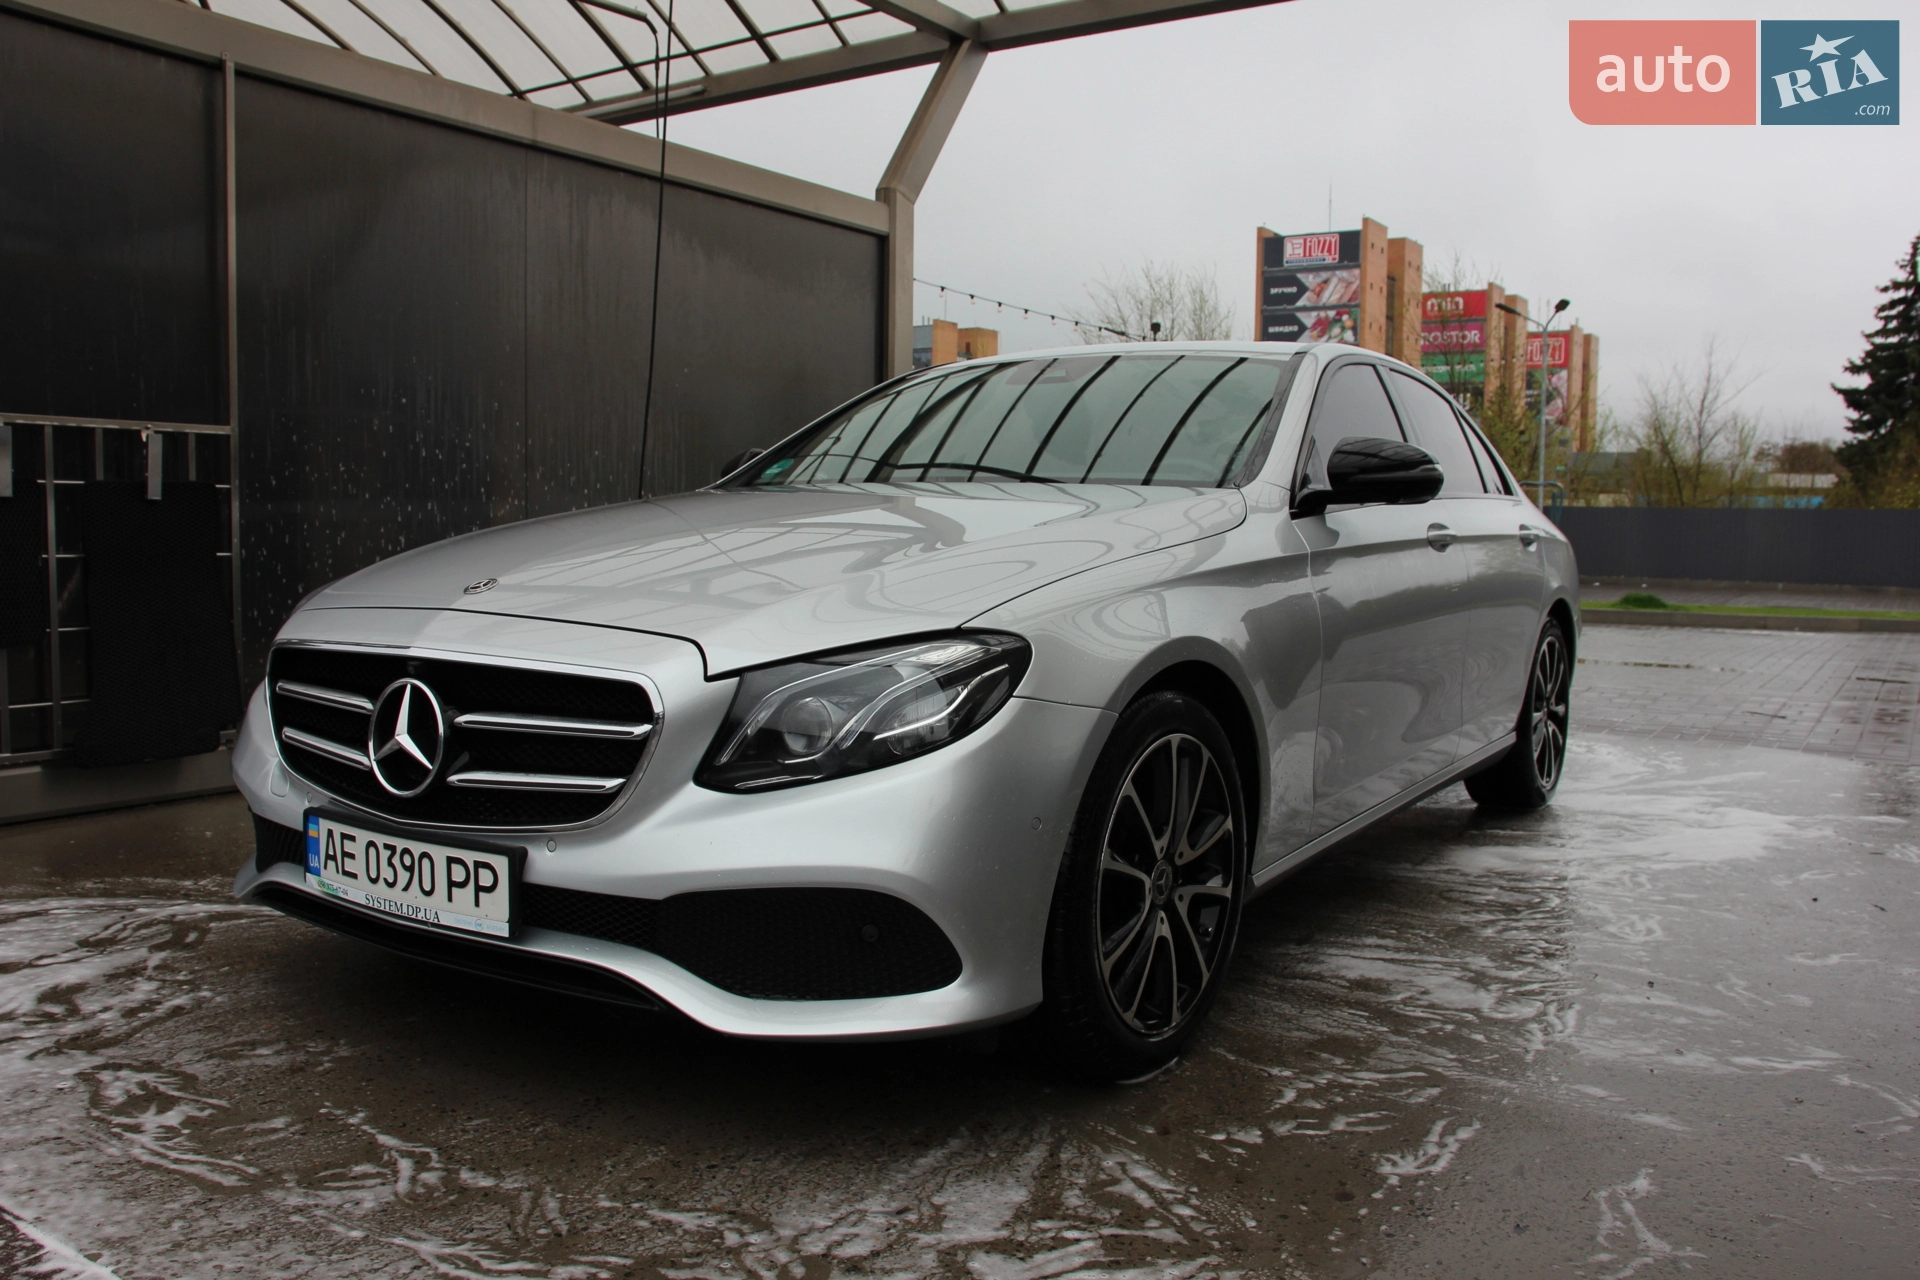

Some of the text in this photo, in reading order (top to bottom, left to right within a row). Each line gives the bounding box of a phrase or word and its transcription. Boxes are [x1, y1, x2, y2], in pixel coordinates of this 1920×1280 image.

[1306, 236, 1338, 257] FOZZY
[1270, 286, 1298, 295] ЗРУЧНО
[1268, 325, 1299, 333] ШВИДКО
[309, 854, 320, 869] UA
[323, 828, 499, 907] AE 0390 PP
[364, 893, 441, 923] SYSTEM.DP.UA
